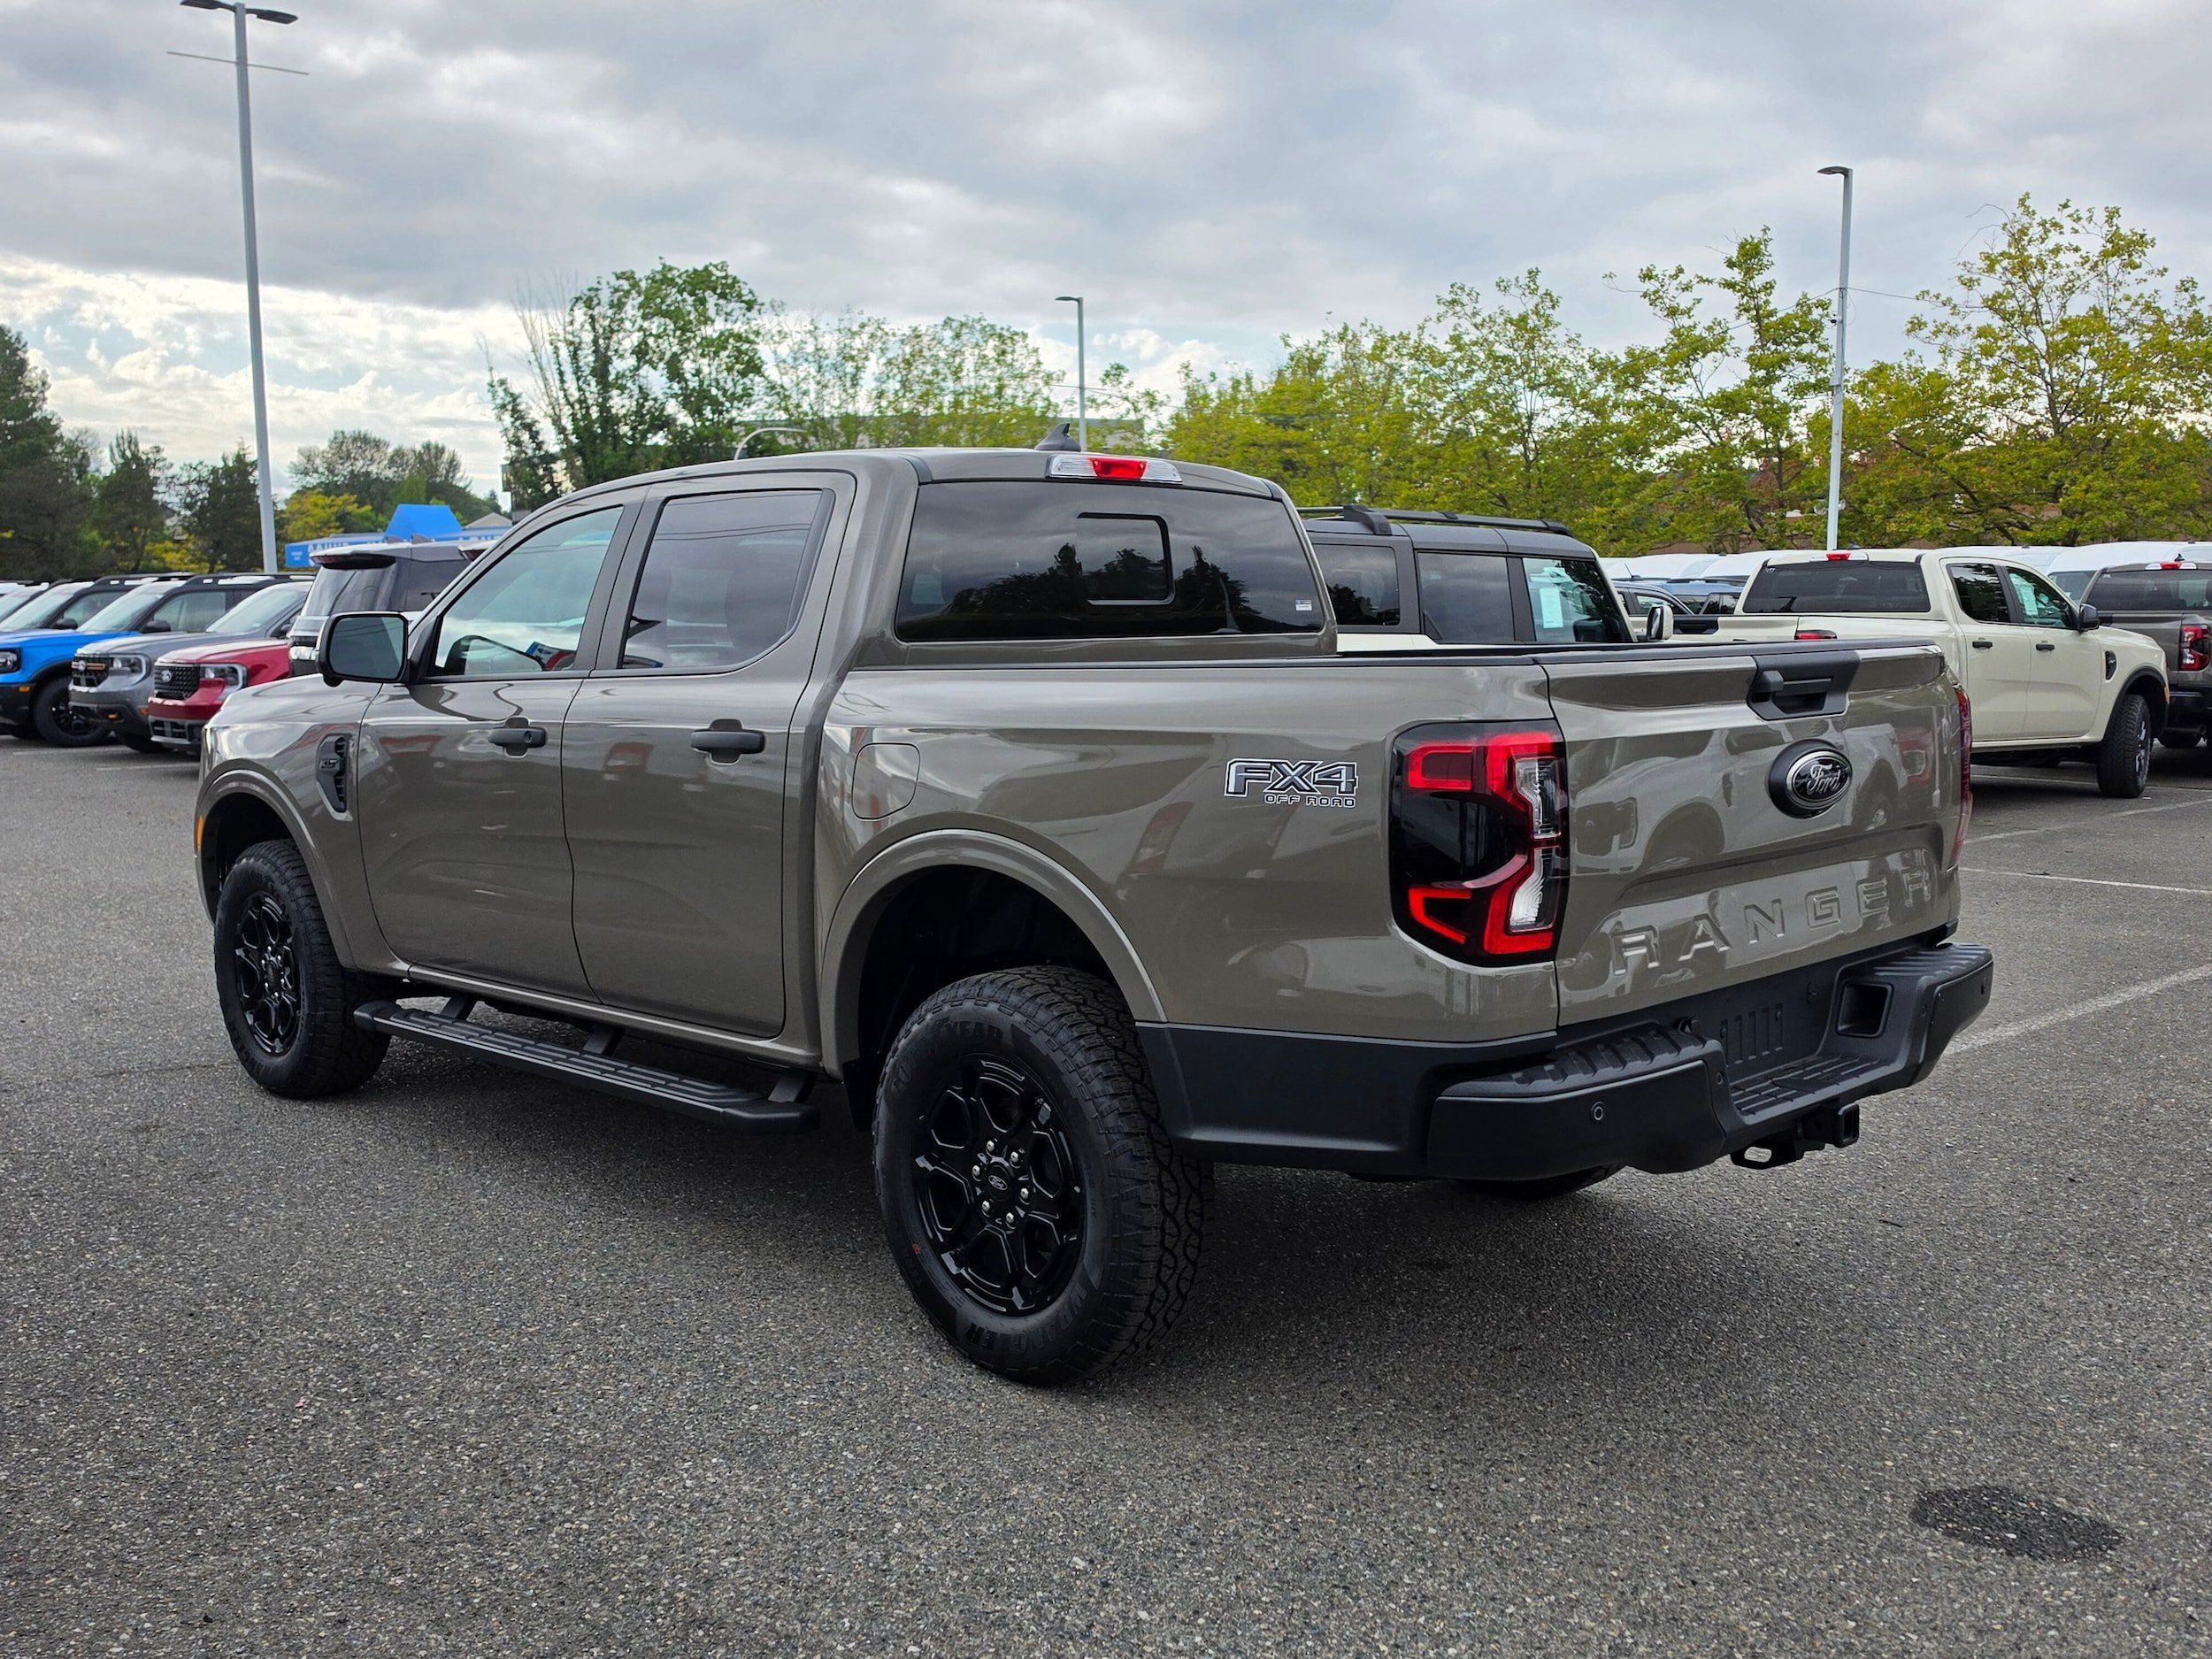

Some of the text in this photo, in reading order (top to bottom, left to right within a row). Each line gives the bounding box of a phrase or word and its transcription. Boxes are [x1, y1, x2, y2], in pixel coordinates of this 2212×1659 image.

[1225, 758, 1358, 796] FX4
[1806, 764, 1842, 795] Ford
[1263, 794, 1356, 809] OFF ROAD
[1610, 868, 1932, 975] RANGER
